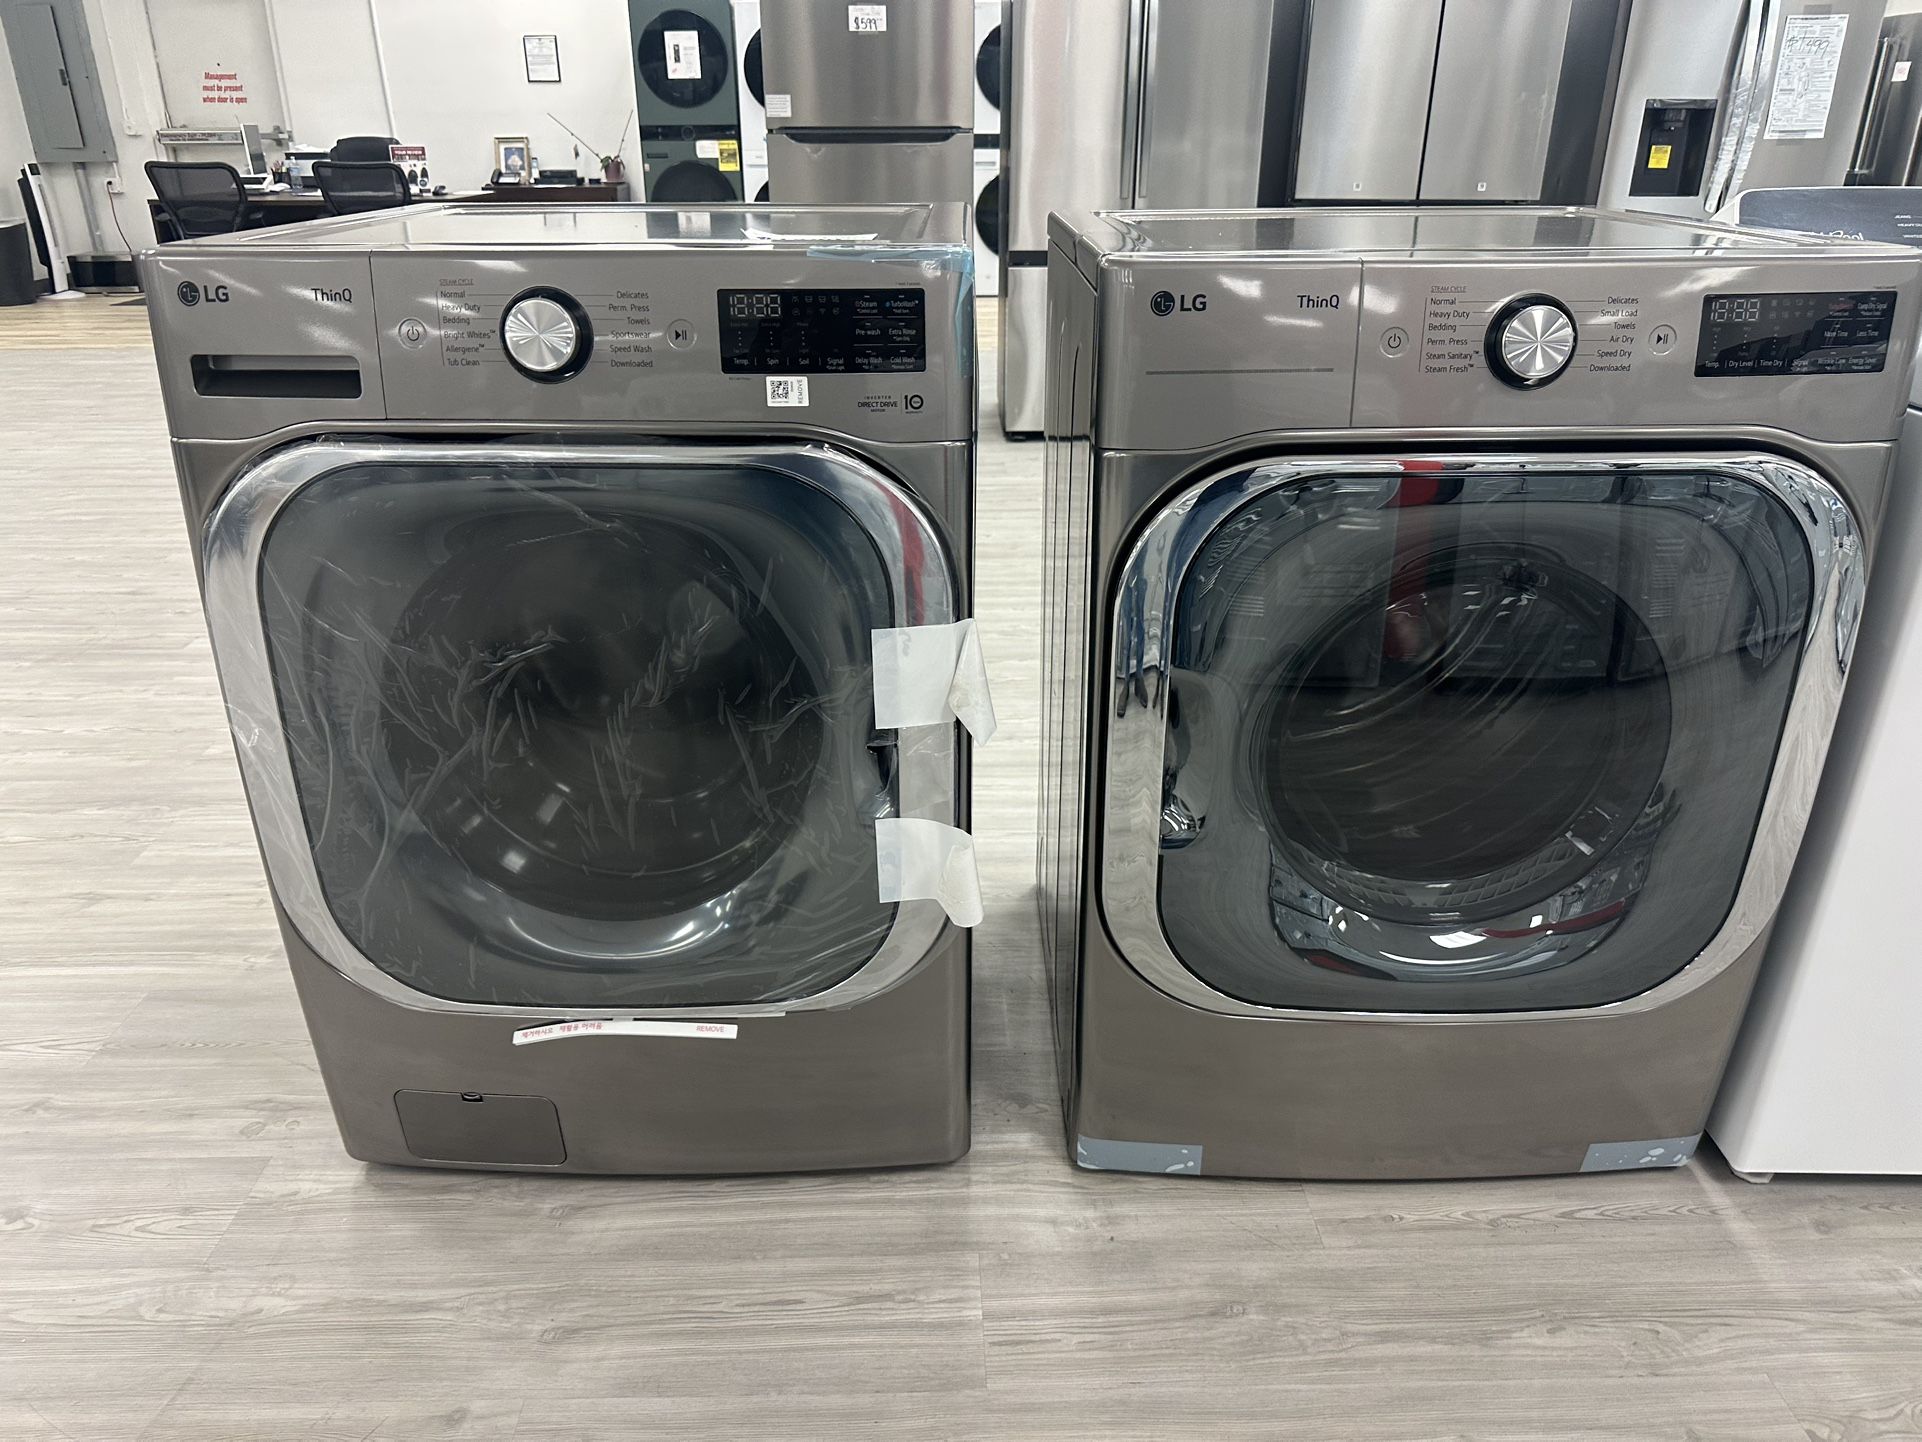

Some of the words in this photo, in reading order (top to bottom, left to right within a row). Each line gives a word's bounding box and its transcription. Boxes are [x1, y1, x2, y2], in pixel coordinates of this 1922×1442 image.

[204, 72, 237, 82] Management
[203, 84, 215, 92] must
[217, 84, 222, 92] be
[223, 84, 243, 93] present
[203, 285, 229, 302] LG
[311, 288, 352, 303] ThinQ
[617, 291, 649, 299] Delicates
[1180, 294, 1207, 312] LG
[1297, 295, 1340, 310] ThinQ
[1608, 296, 1639, 304] Delicates
[442, 303, 462, 312] Heavy
[465, 303, 480, 313] Duty
[609, 304, 628, 312] Perm.
[631, 304, 650, 312] Press
[1430, 310, 1451, 319] Heavy
[1453, 310, 1470, 319] Duty
[1601, 309, 1619, 317] Small
[1621, 309, 1638, 317] Load
[443, 316, 470, 325] Bedding
[627, 317, 650, 325] Towels
[1429, 323, 1456, 333] Bedding
[1614, 322, 1636, 330] Towels
[444, 331, 465, 340] Bright
[611, 330, 650, 339] Sportswear
[1609, 335, 1620, 343] Air
[1621, 335, 1634, 344] Dry
[610, 345, 631, 353] Speed
[1426, 352, 1445, 360] Steam
[1597, 349, 1617, 359] Speed
[1619, 349, 1632, 358] Dry
[447, 358, 459, 366] Tub
[461, 358, 480, 366] Clean
[734, 358, 749, 366] Temp.
[827, 357, 844, 365] Signal
[856, 357, 869, 365] Delay
[1729, 360, 1738, 368] Dry
[1425, 365, 1447, 373] Steam
[1590, 364, 1631, 372] Downloaded
[904, 394, 924, 410] 10
[696, 1025, 725, 1033] REMOVE
